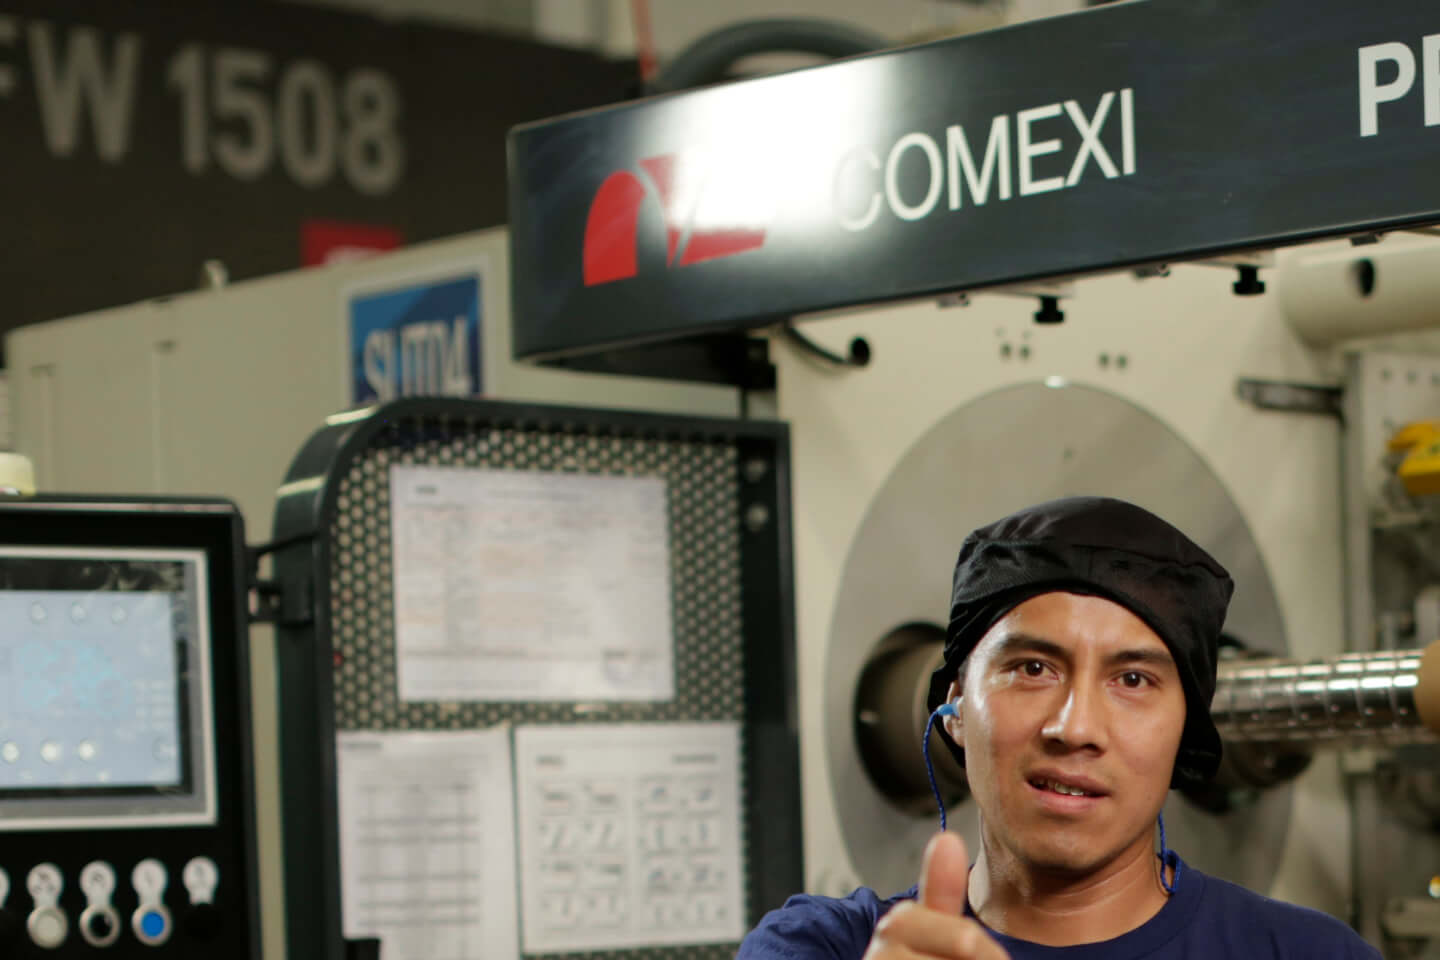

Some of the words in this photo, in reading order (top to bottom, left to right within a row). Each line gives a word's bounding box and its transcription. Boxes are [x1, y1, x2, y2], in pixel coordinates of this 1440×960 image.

[0, 15, 141, 160] W
[166, 42, 404, 196] 1508
[833, 87, 1137, 233] COMEXI
